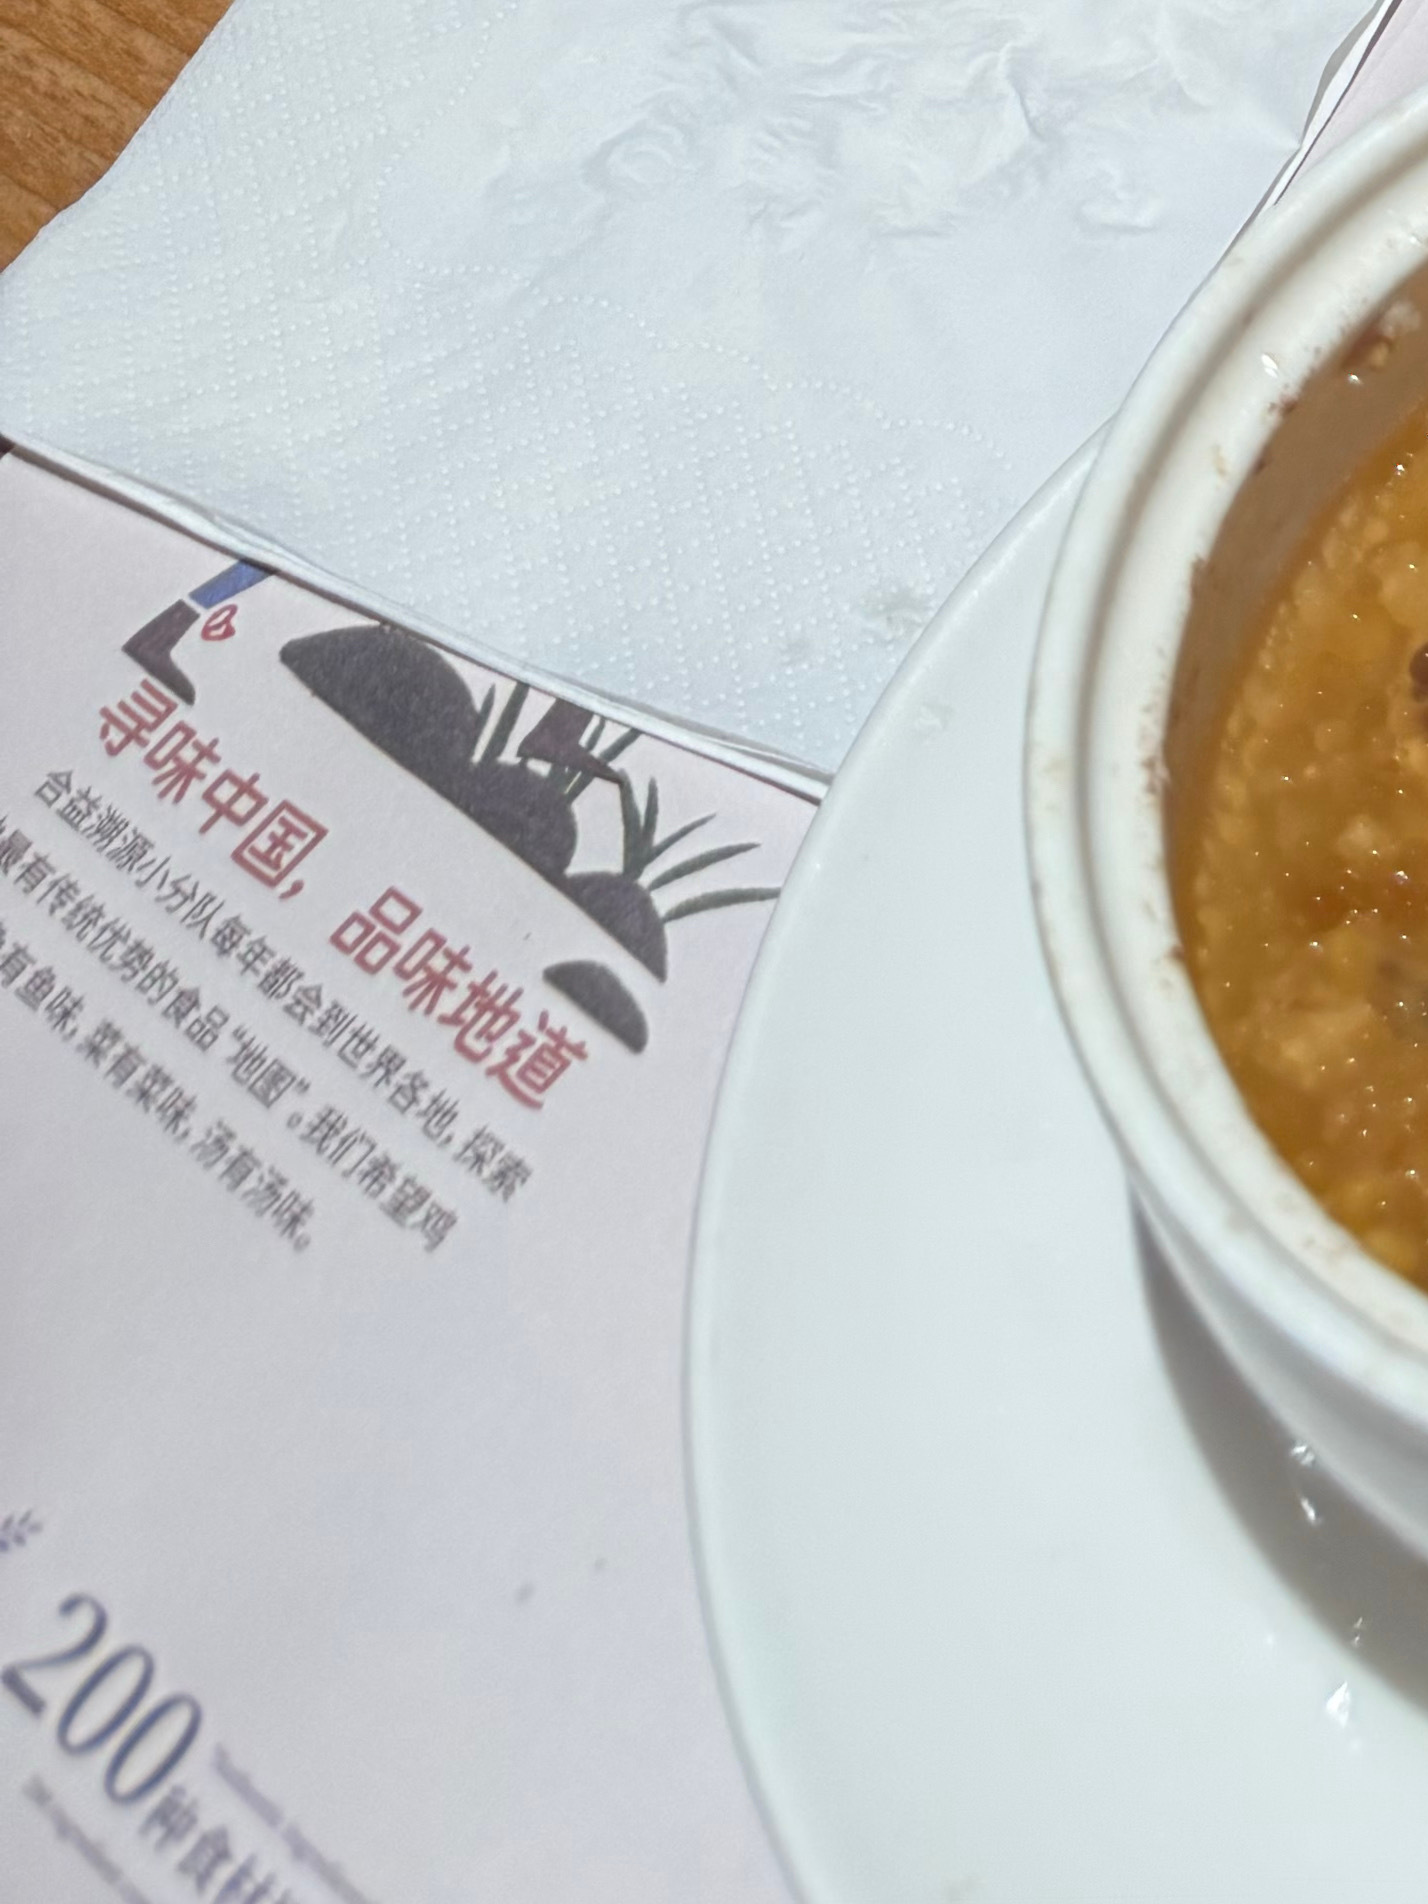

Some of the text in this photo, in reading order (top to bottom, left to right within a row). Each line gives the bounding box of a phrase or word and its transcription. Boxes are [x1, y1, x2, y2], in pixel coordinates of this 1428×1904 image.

[0, 812, 460, 1254] 最有传统优势的食品“地图”。我们希望鸡
[0, 919, 316, 1253] 有鱼味，菜有菜味，汤有汤味。
[1, 1592, 204, 1805] 200
